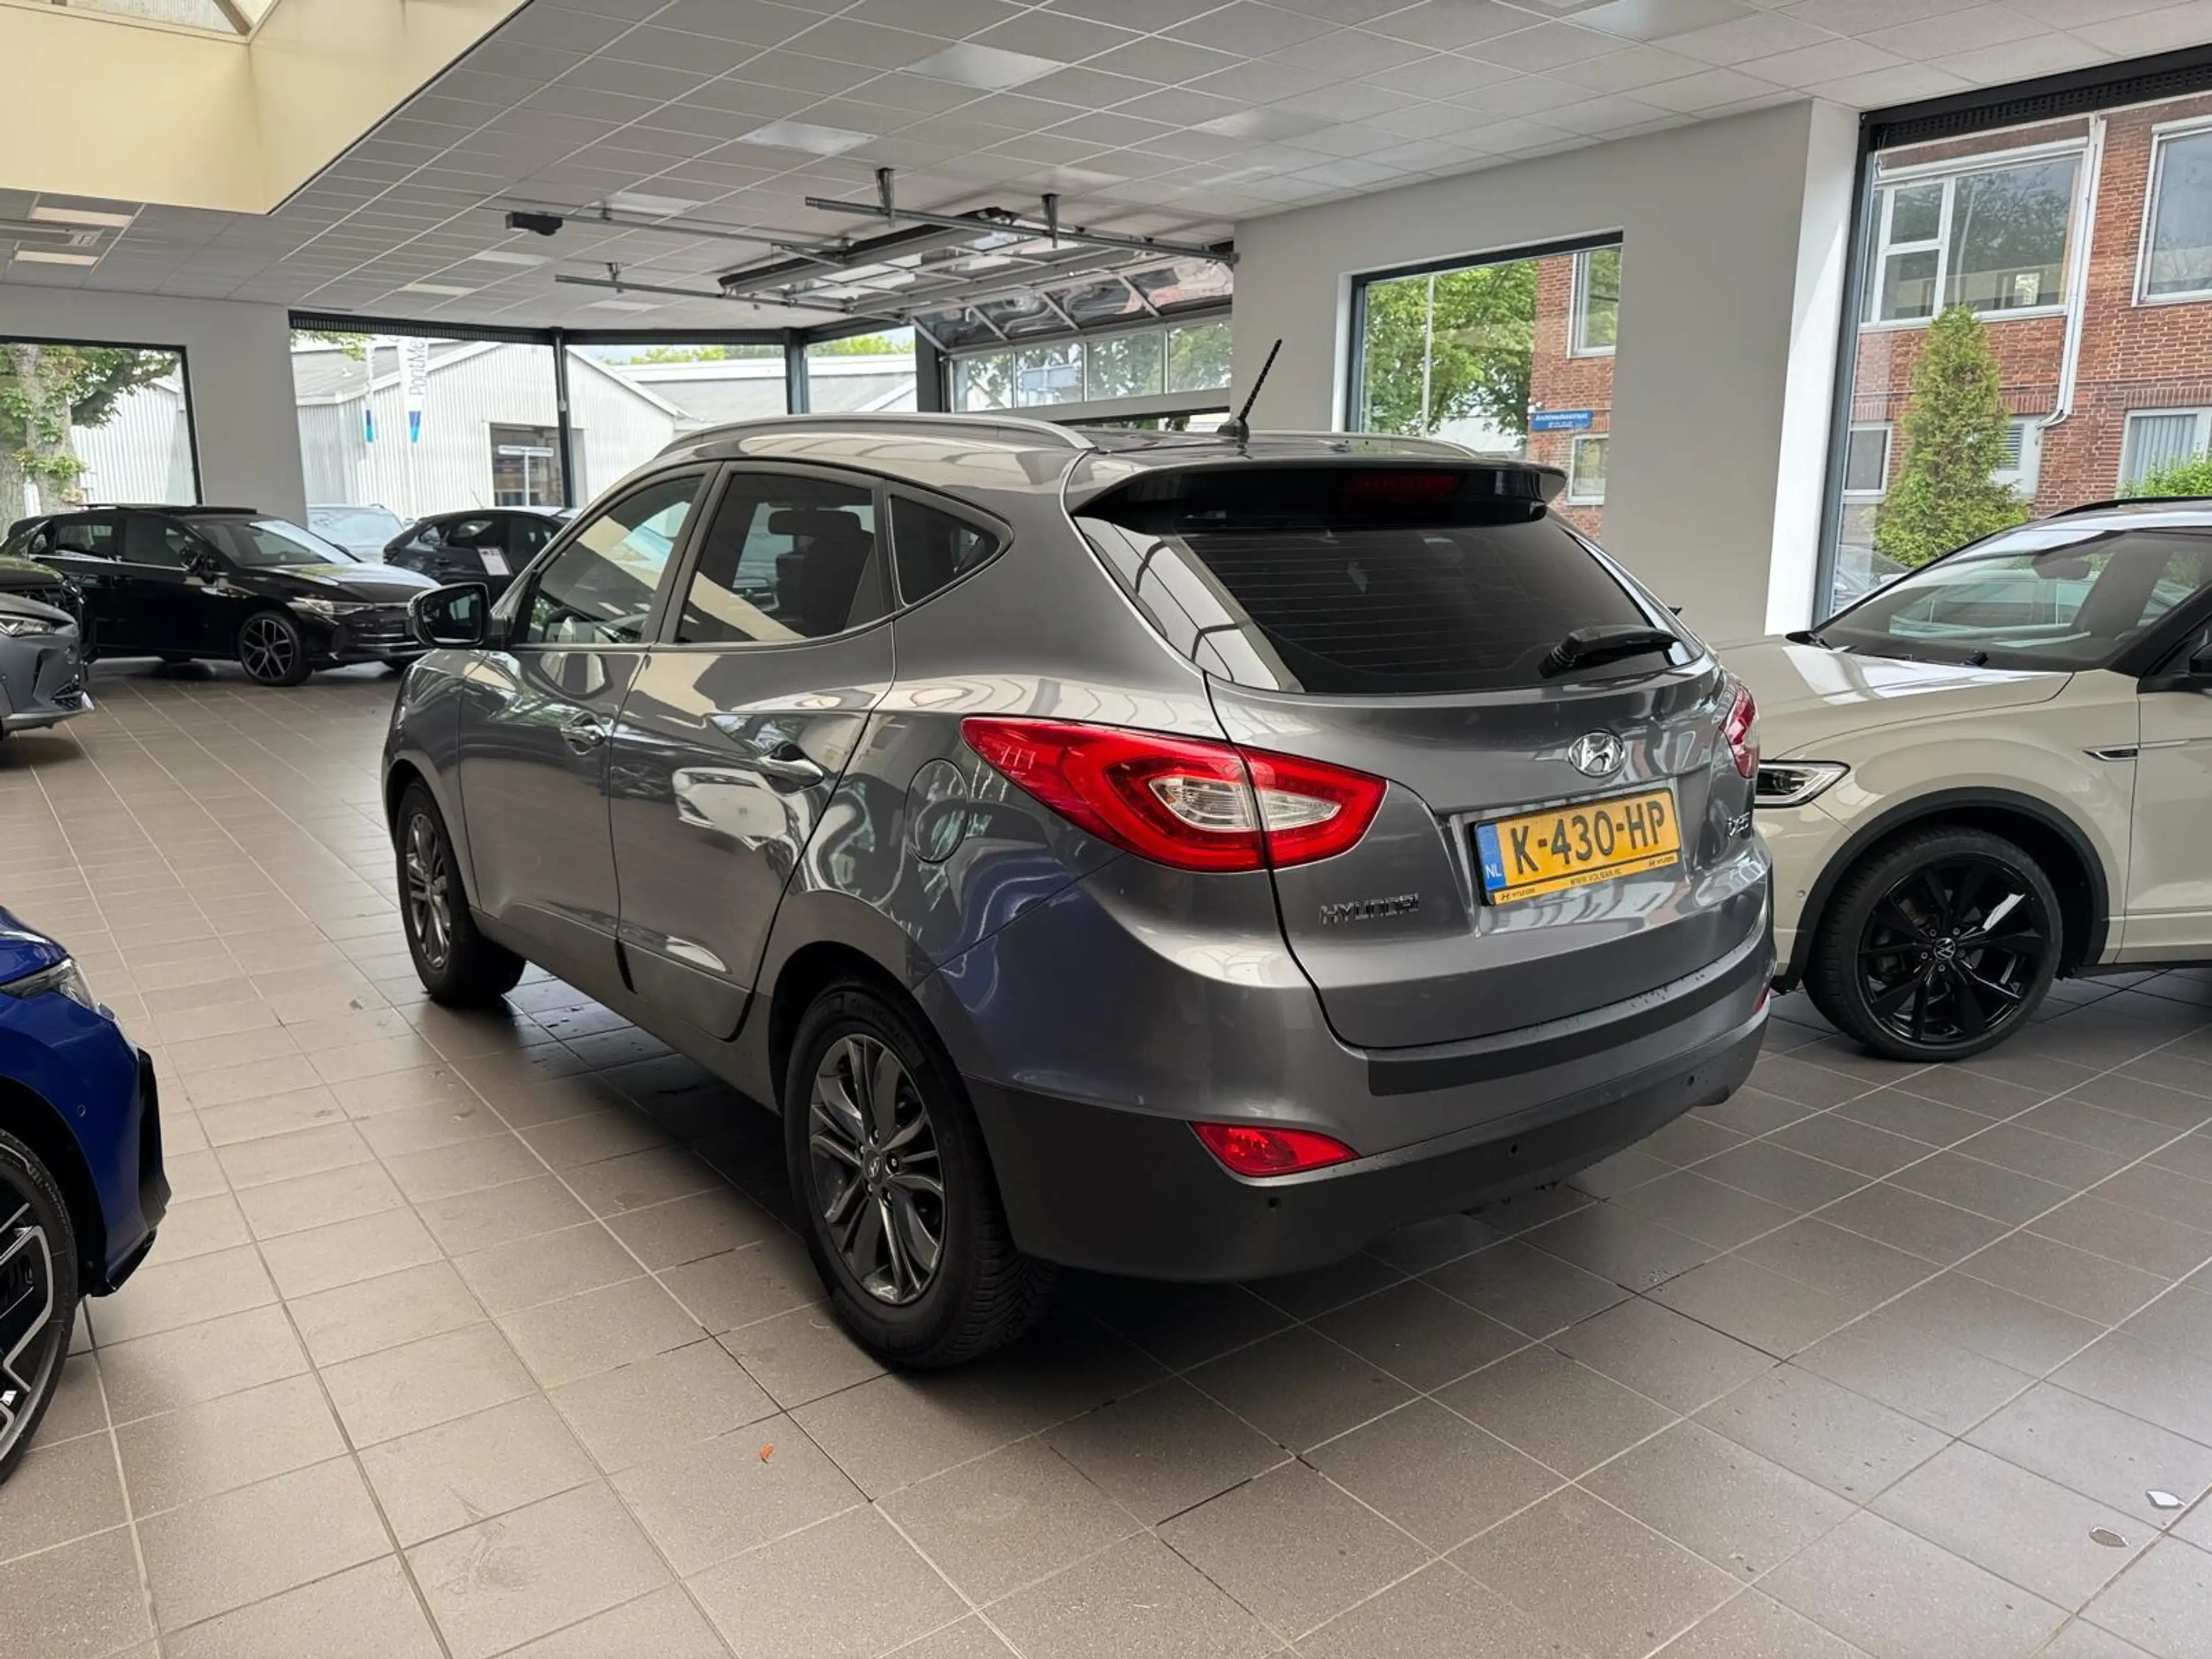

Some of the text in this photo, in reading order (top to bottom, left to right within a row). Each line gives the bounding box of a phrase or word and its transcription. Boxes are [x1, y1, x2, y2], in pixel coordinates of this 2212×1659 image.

[1510, 800, 1665, 874] K-430-HP
[1486, 865, 1502, 879] NL
[1319, 892, 1419, 925] HYUNDAI
